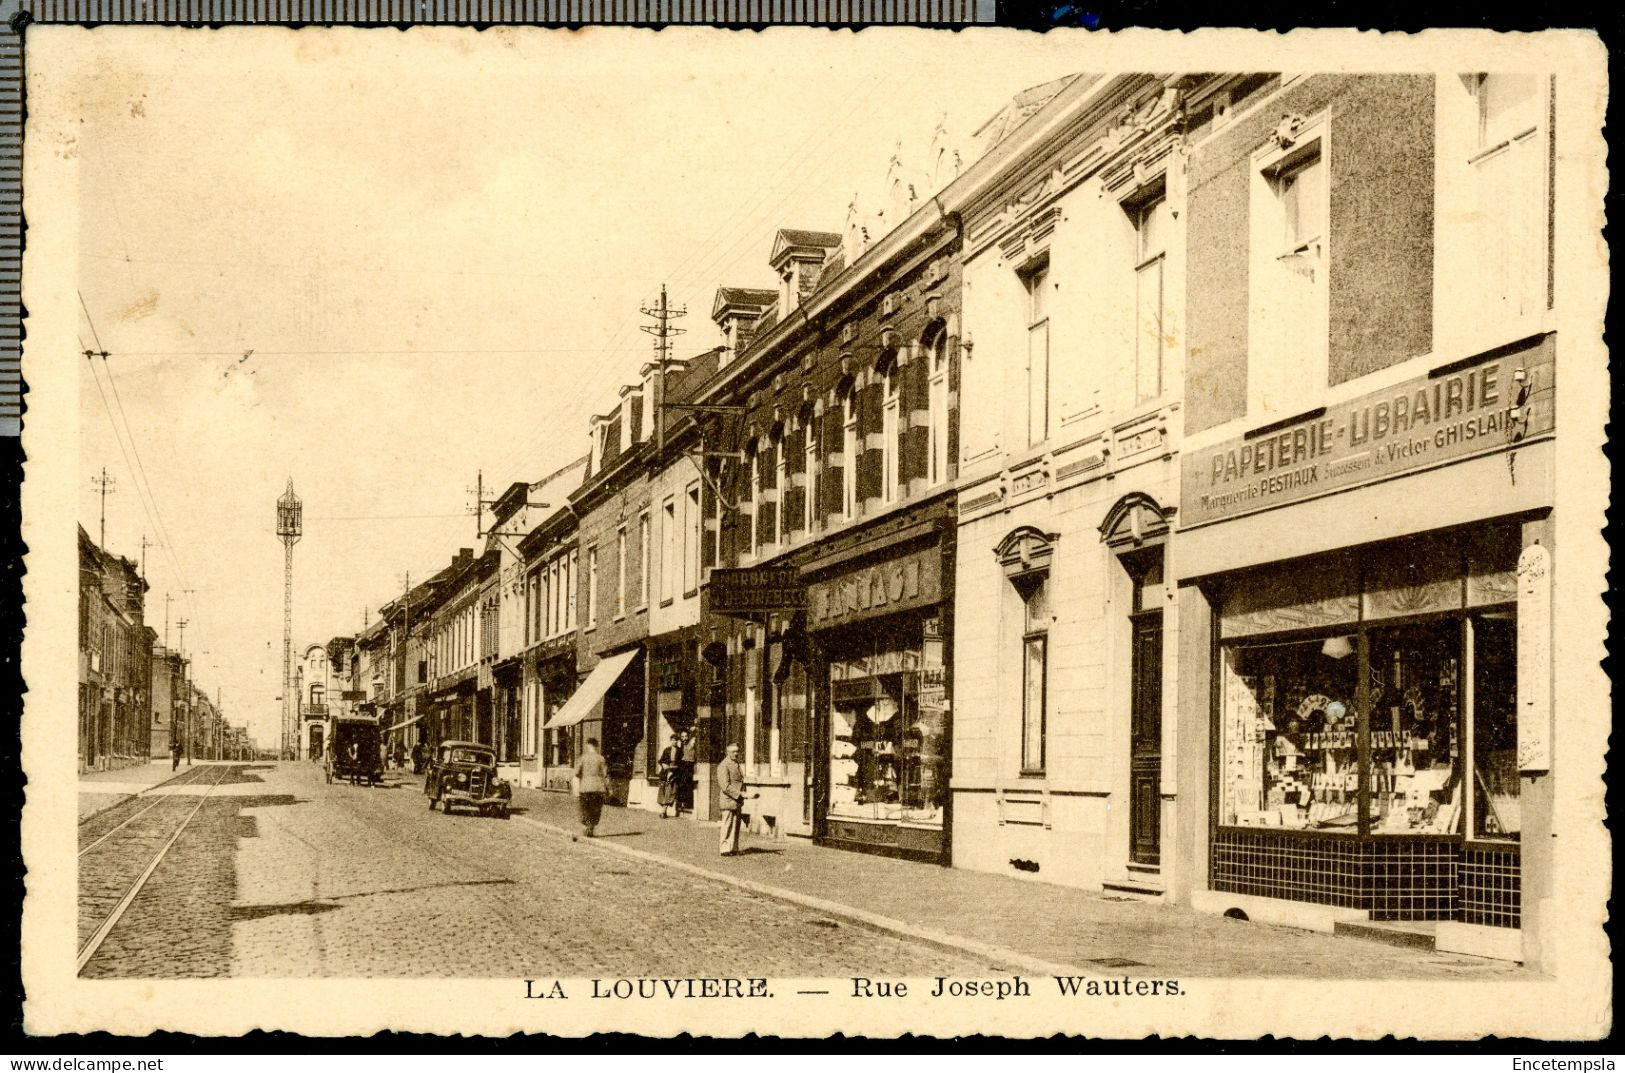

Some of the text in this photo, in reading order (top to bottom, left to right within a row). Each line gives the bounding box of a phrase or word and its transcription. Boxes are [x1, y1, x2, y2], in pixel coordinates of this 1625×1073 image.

[1200, 483, 1259, 513] Marguerite
[1260, 464, 1319, 497] PESTIAUX
[1386, 436, 1431, 463] Victor
